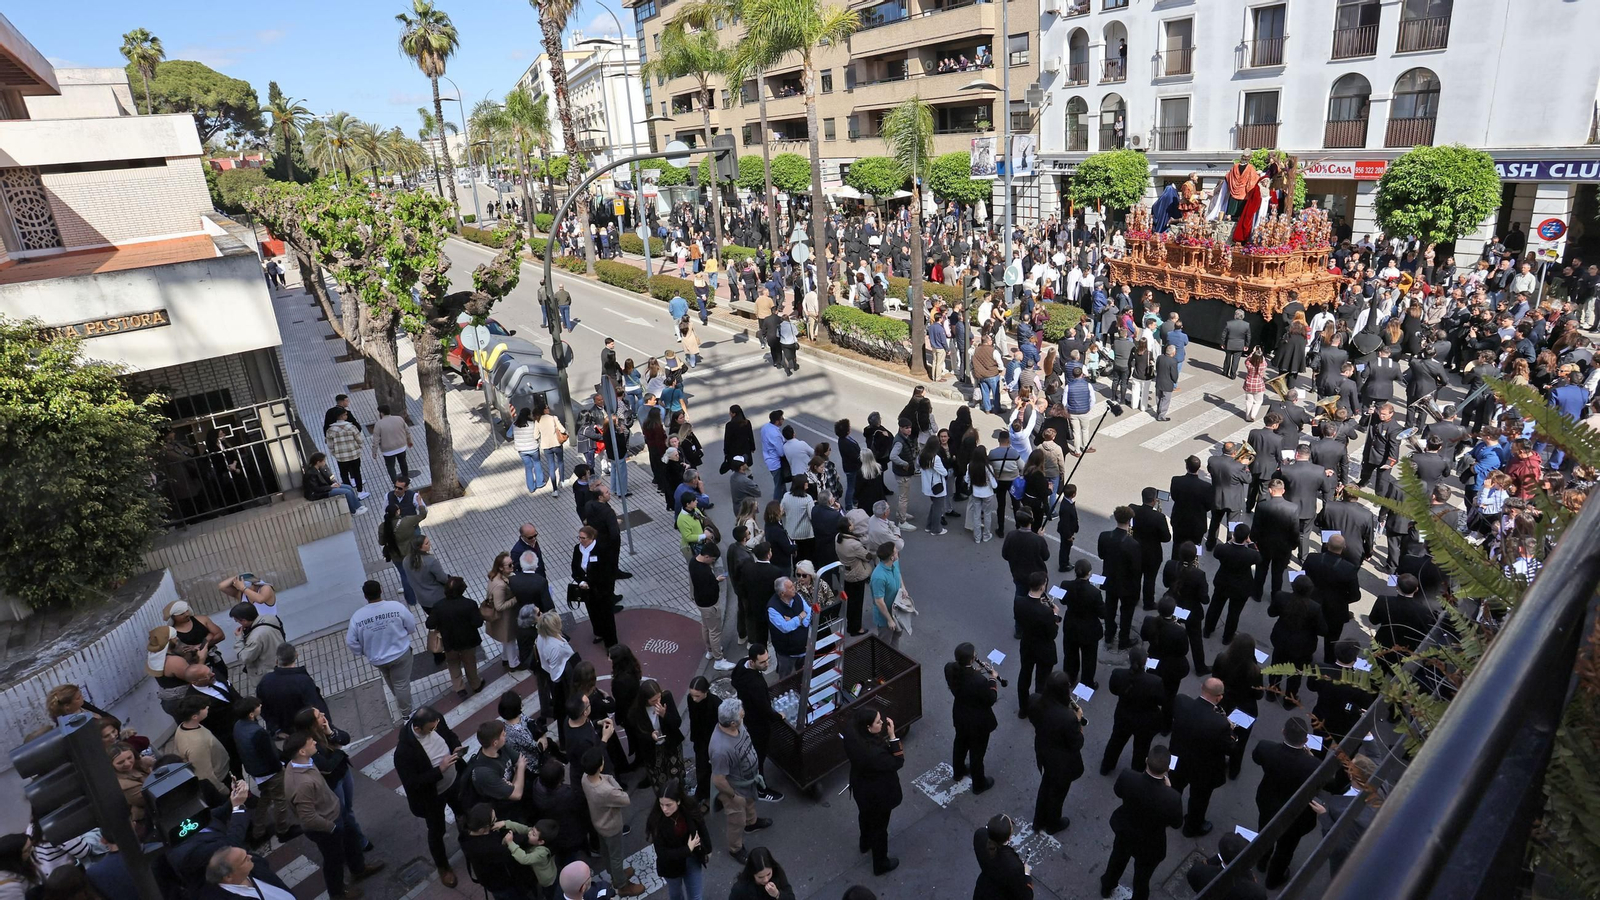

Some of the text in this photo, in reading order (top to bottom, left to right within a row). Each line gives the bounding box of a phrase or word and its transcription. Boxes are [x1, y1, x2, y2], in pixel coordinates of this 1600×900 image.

[1549, 163, 1600, 178] CLU
[84, 311, 166, 335] PASTORA
[375, 611, 400, 621] PROJECTS
